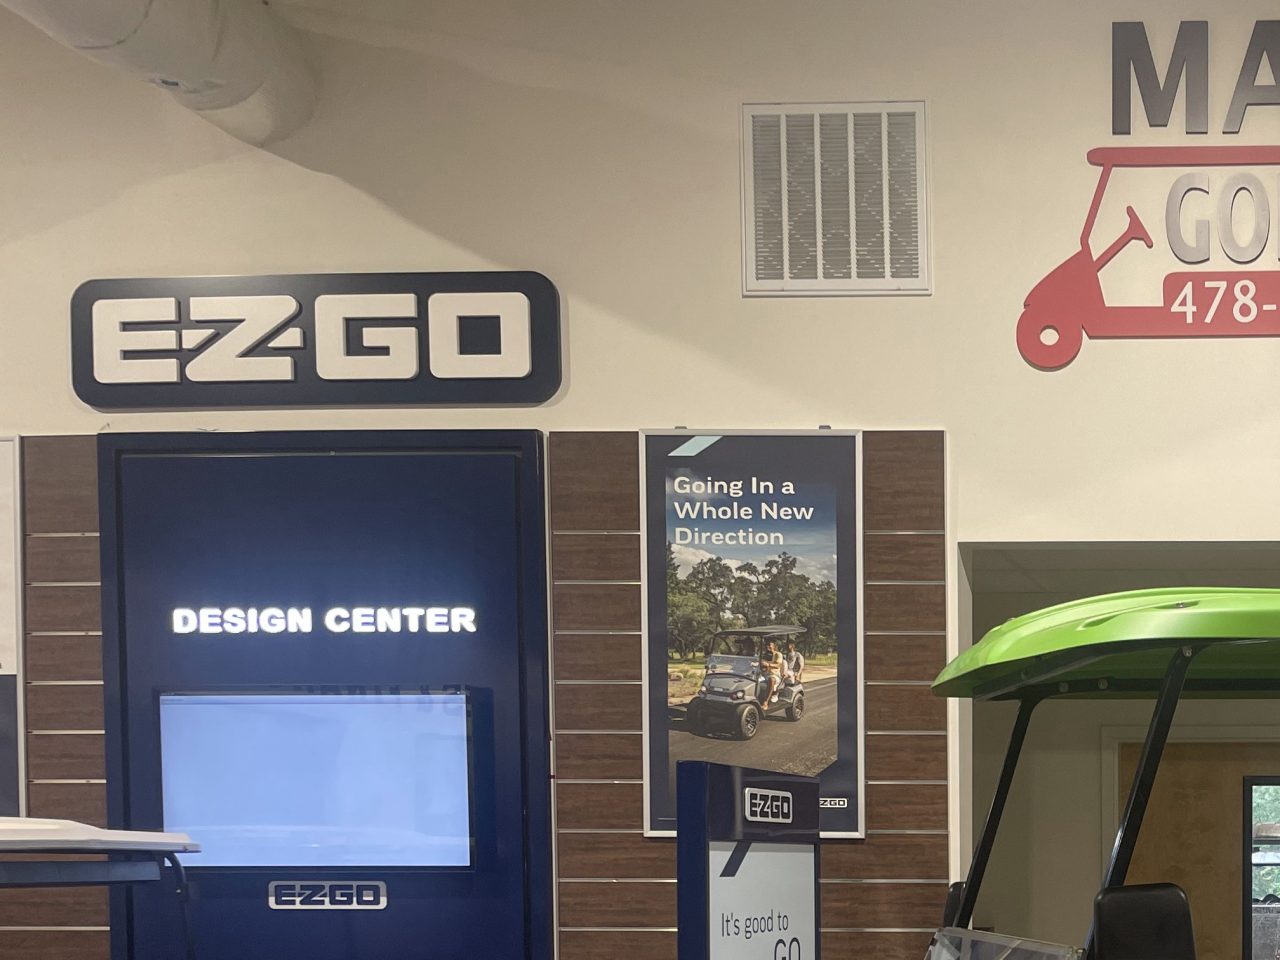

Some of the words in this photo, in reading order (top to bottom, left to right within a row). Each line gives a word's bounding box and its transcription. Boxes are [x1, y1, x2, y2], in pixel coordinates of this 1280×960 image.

[673, 476, 744, 498] Going
[751, 477, 774, 495] In
[781, 481, 796, 495] a
[673, 501, 753, 520] Whole
[760, 502, 815, 520] New
[674, 526, 784, 545] Direction
[172, 607, 313, 634] DESIGN
[324, 606, 478, 633] CENTER
[819, 799, 847, 807] ZGO
[721, 912, 740, 937] It's
[744, 908, 774, 940] good
[777, 911, 789, 932] to
